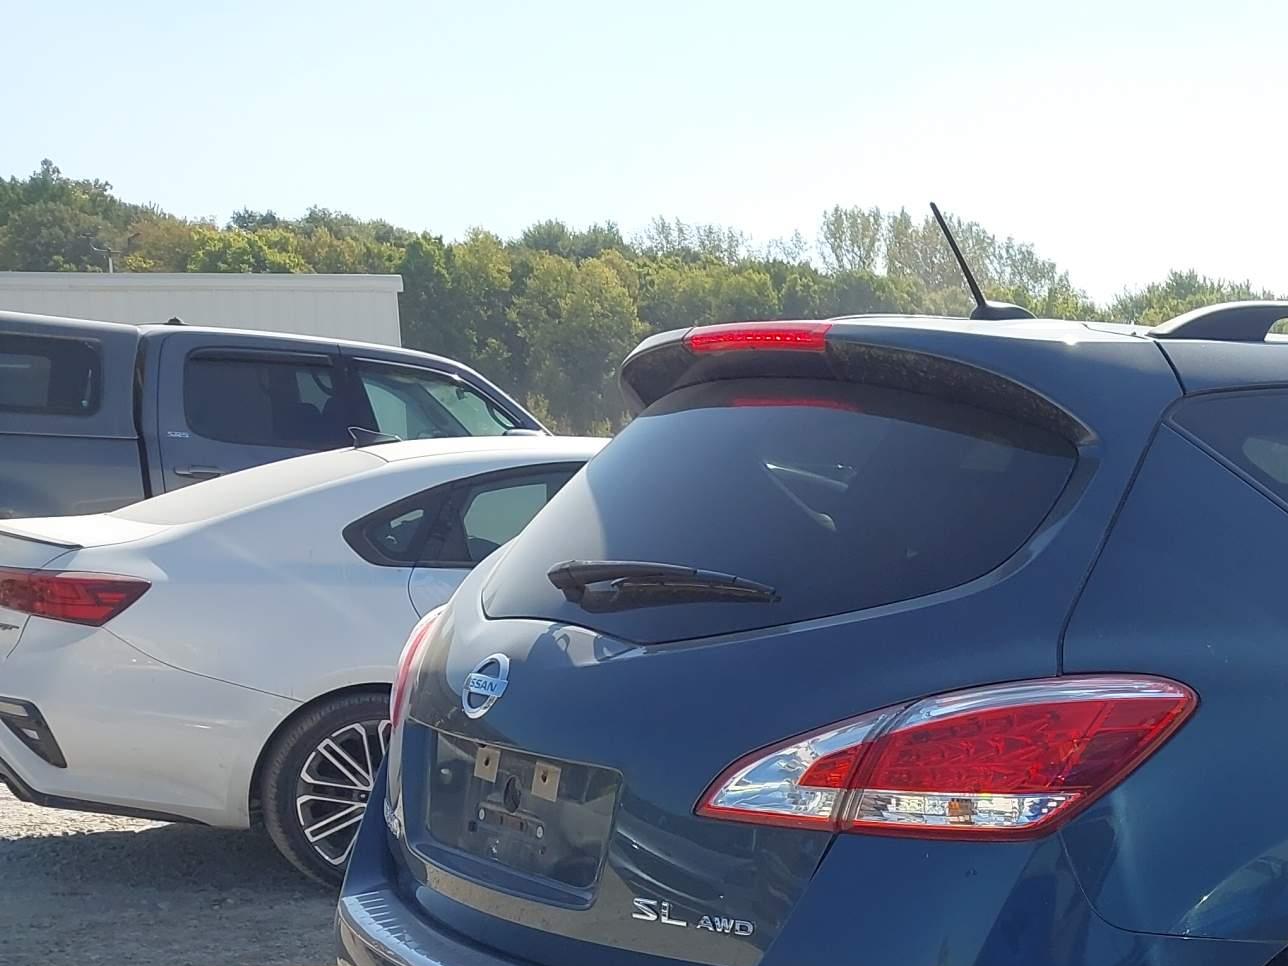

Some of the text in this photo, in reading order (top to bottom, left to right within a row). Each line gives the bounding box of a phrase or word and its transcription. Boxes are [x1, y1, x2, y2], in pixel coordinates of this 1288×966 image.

[465, 677, 497, 692] SSAN
[631, 897, 754, 936] SL AWD
